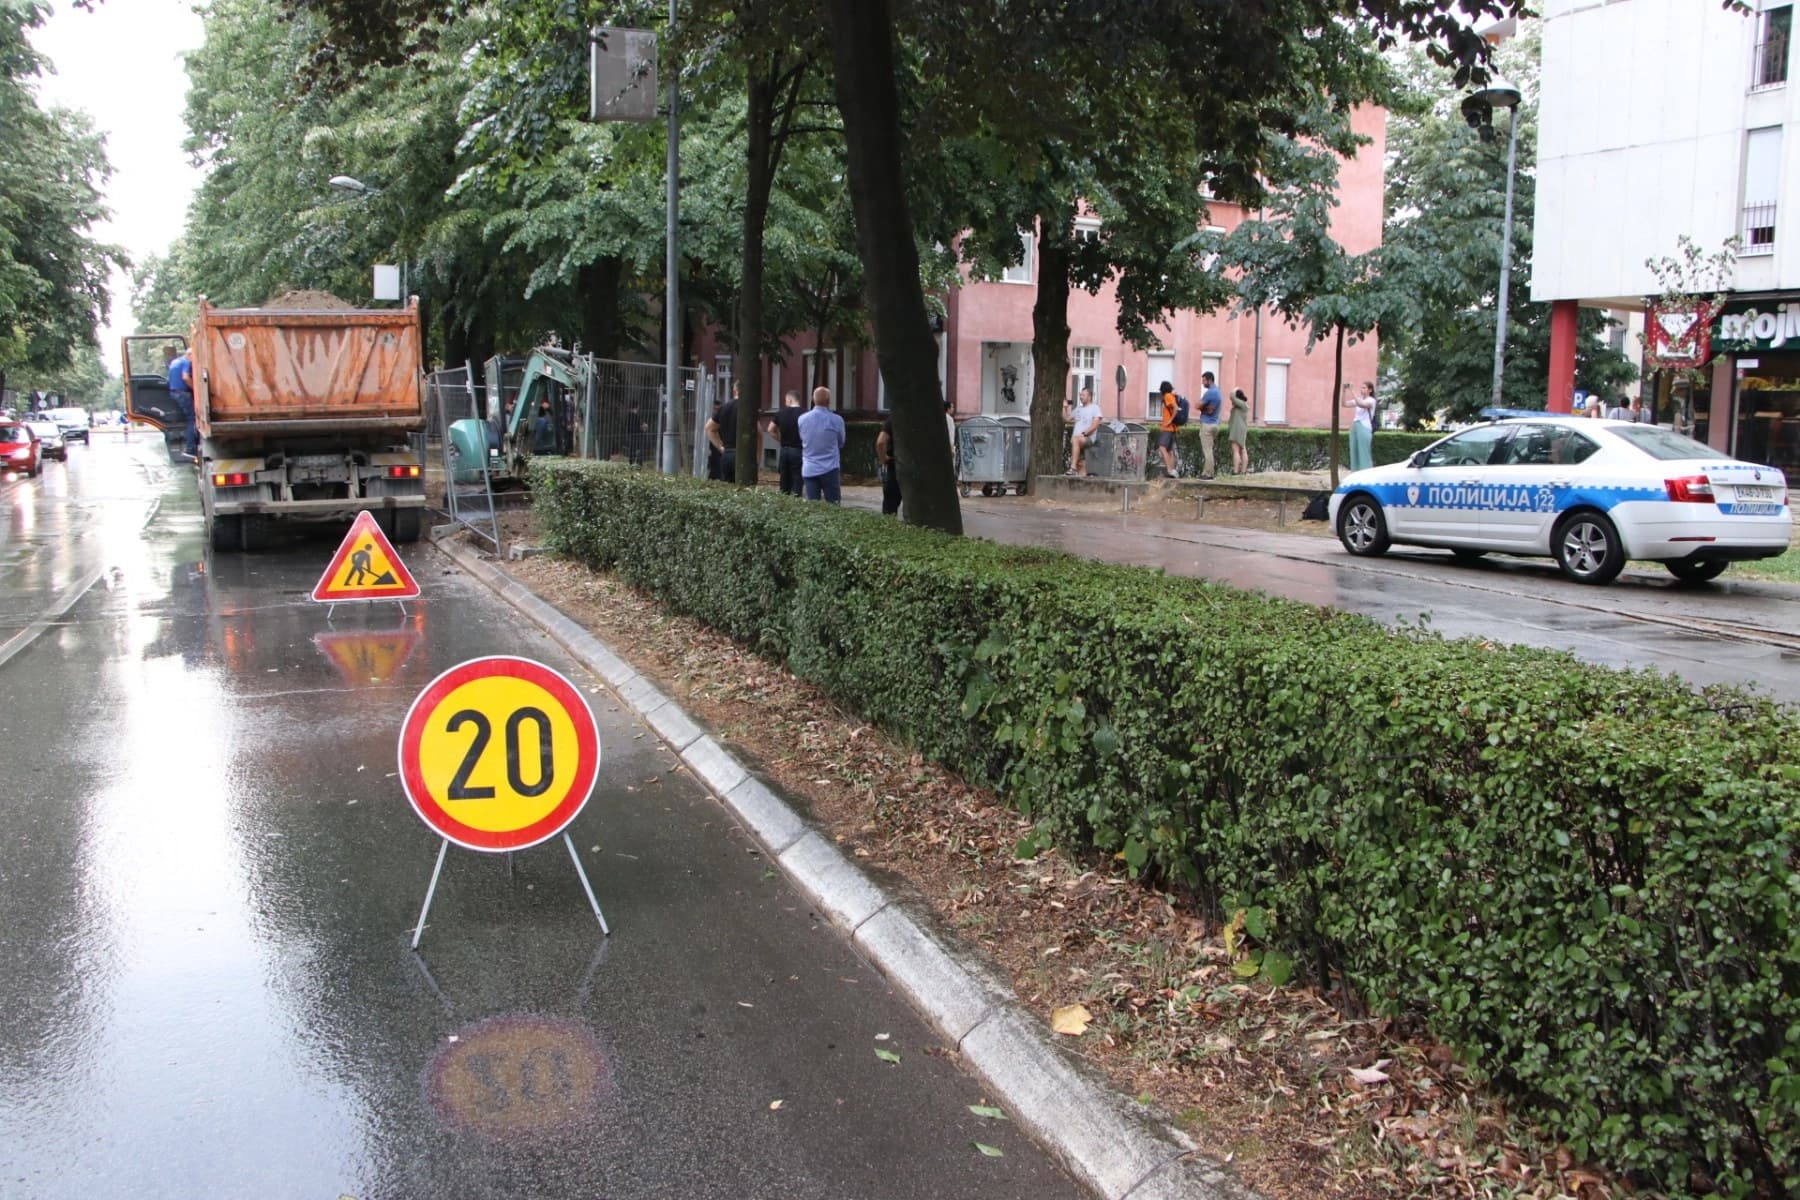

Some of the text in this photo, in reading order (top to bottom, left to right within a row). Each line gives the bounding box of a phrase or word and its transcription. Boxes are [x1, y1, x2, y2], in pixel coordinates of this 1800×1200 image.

[1428, 487, 1556, 509] ПОЛИЦИЈА 122
[446, 706, 554, 800] 20
